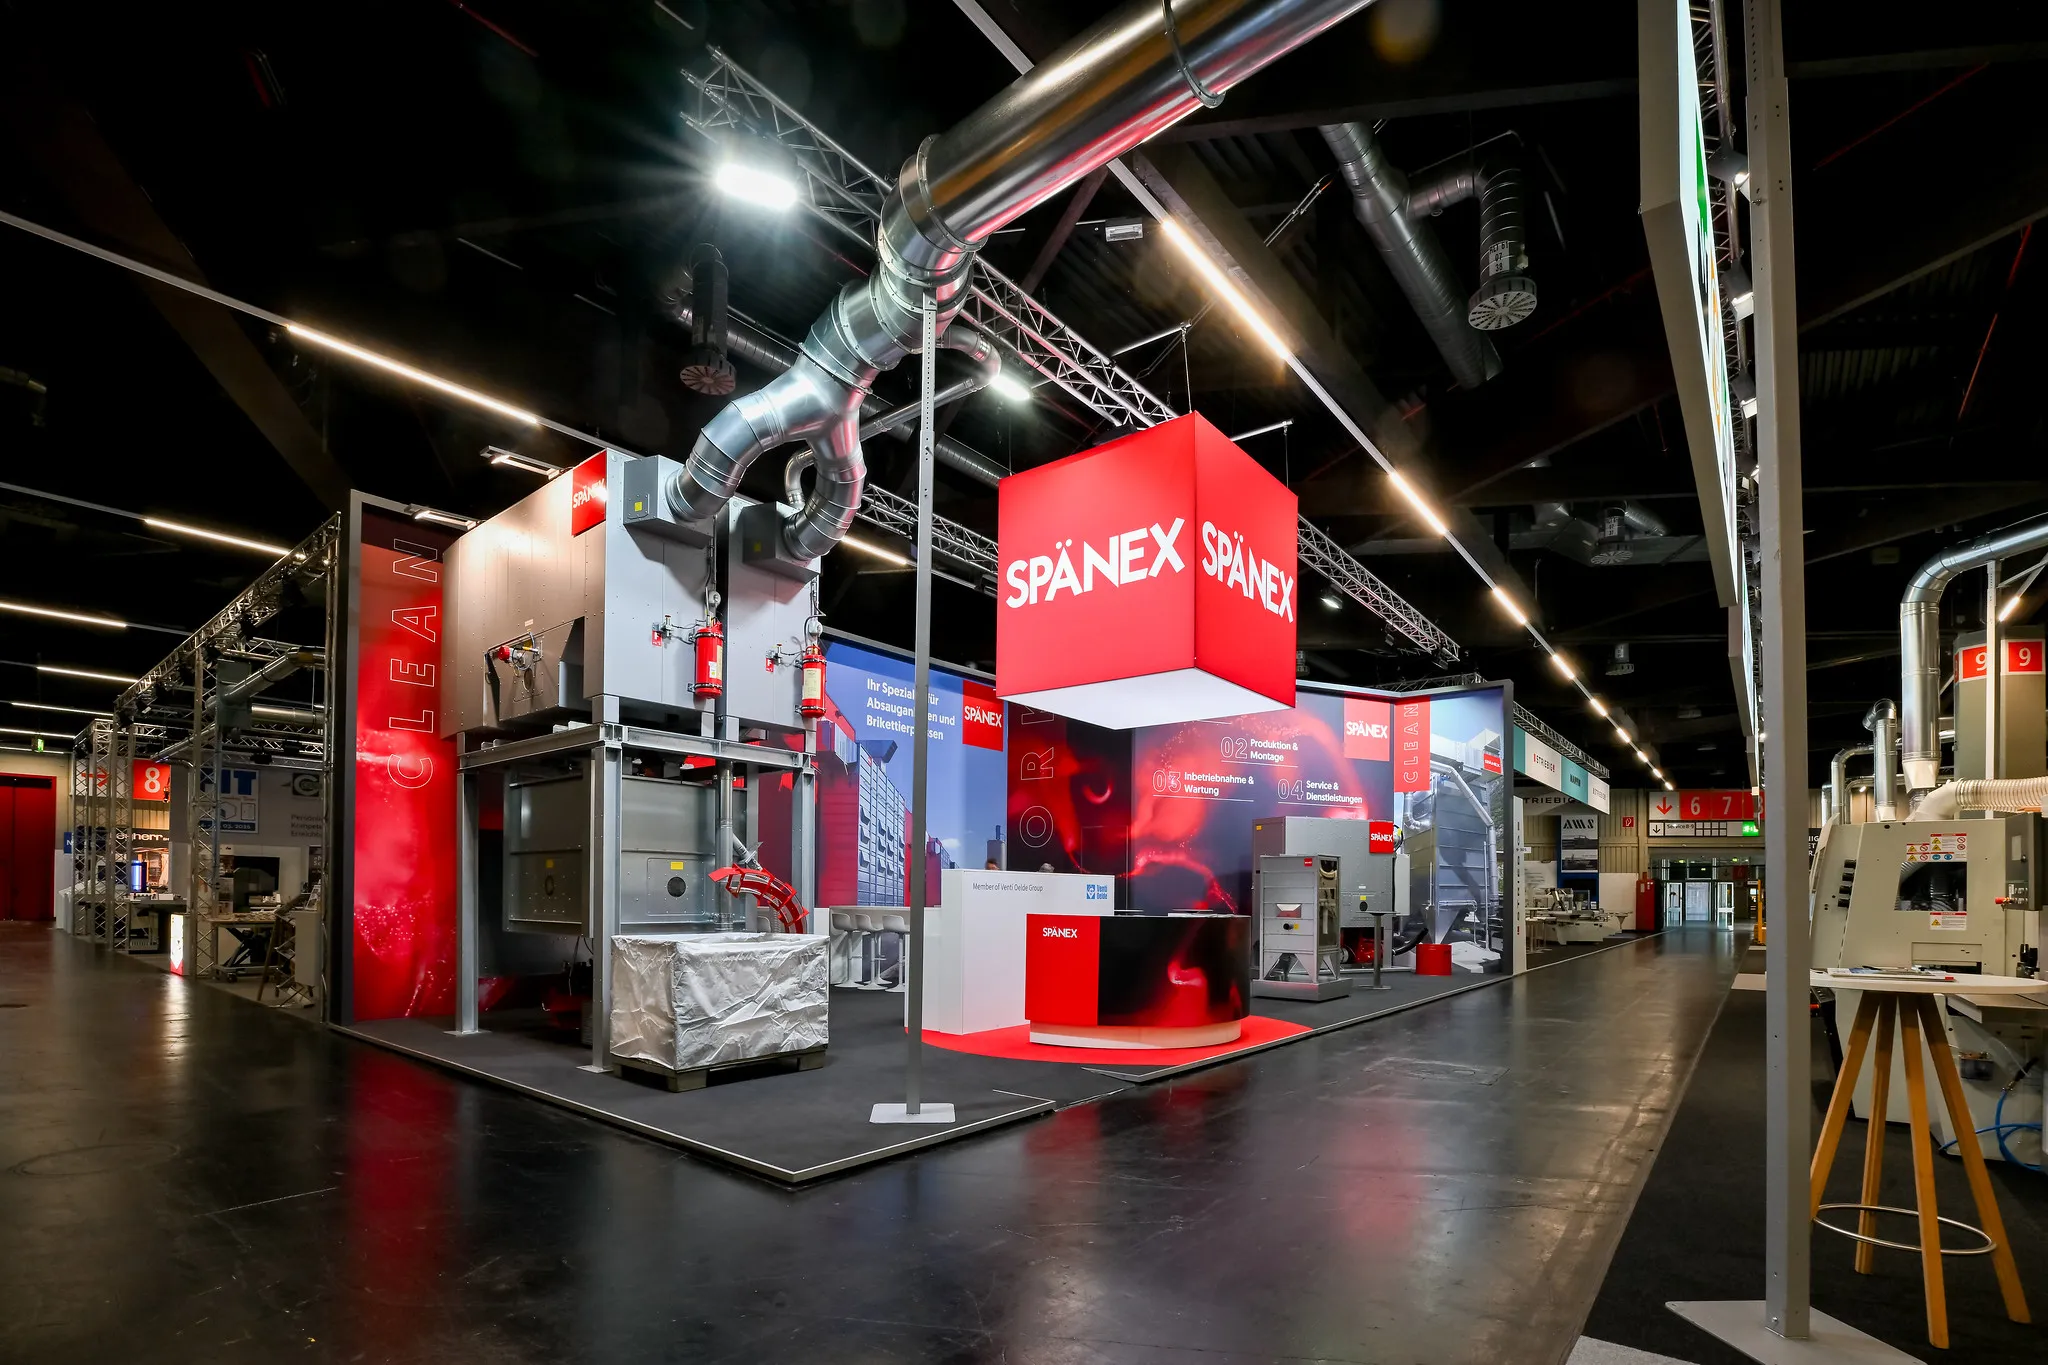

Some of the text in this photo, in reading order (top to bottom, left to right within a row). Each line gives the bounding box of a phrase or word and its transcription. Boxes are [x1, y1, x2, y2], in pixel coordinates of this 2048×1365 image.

[1006, 517, 1185, 608] SPÄNEX
[1202, 521, 1294, 623] SPÄNEX
[387, 538, 437, 788] CLEAN
[1975, 651, 1987, 671] 9
[2019, 647, 2031, 667] 9
[867, 678, 880, 691] Ihr
[882, 682, 914, 700] Spezial
[867, 697, 956, 726] Absauganen und
[964, 705, 1002, 728] SPÄNEX
[867, 715, 944, 740] Brikettierpsen
[1346, 720, 1388, 738] SPÄNEX
[1220, 736, 1298, 759] 02 Produktion &
[1403, 704, 1418, 783] CLEAN
[1250, 751, 1284, 762] Montage
[144, 767, 161, 793] 8
[1152, 770, 1254, 792] 03 Inbetriebnahme &
[1184, 785, 1219, 796] Wartung
[1277, 778, 1339, 800] 04 Service &
[1306, 791, 1363, 804] Dienstleistungen
[1690, 796, 1701, 815] 6
[1722, 796, 1732, 815] 7
[1370, 832, 1393, 842] SPÄNEX
[972, 882, 1043, 892] Member of Venti Oelde Group
[1042, 926, 1078, 938] SPÄNEX
